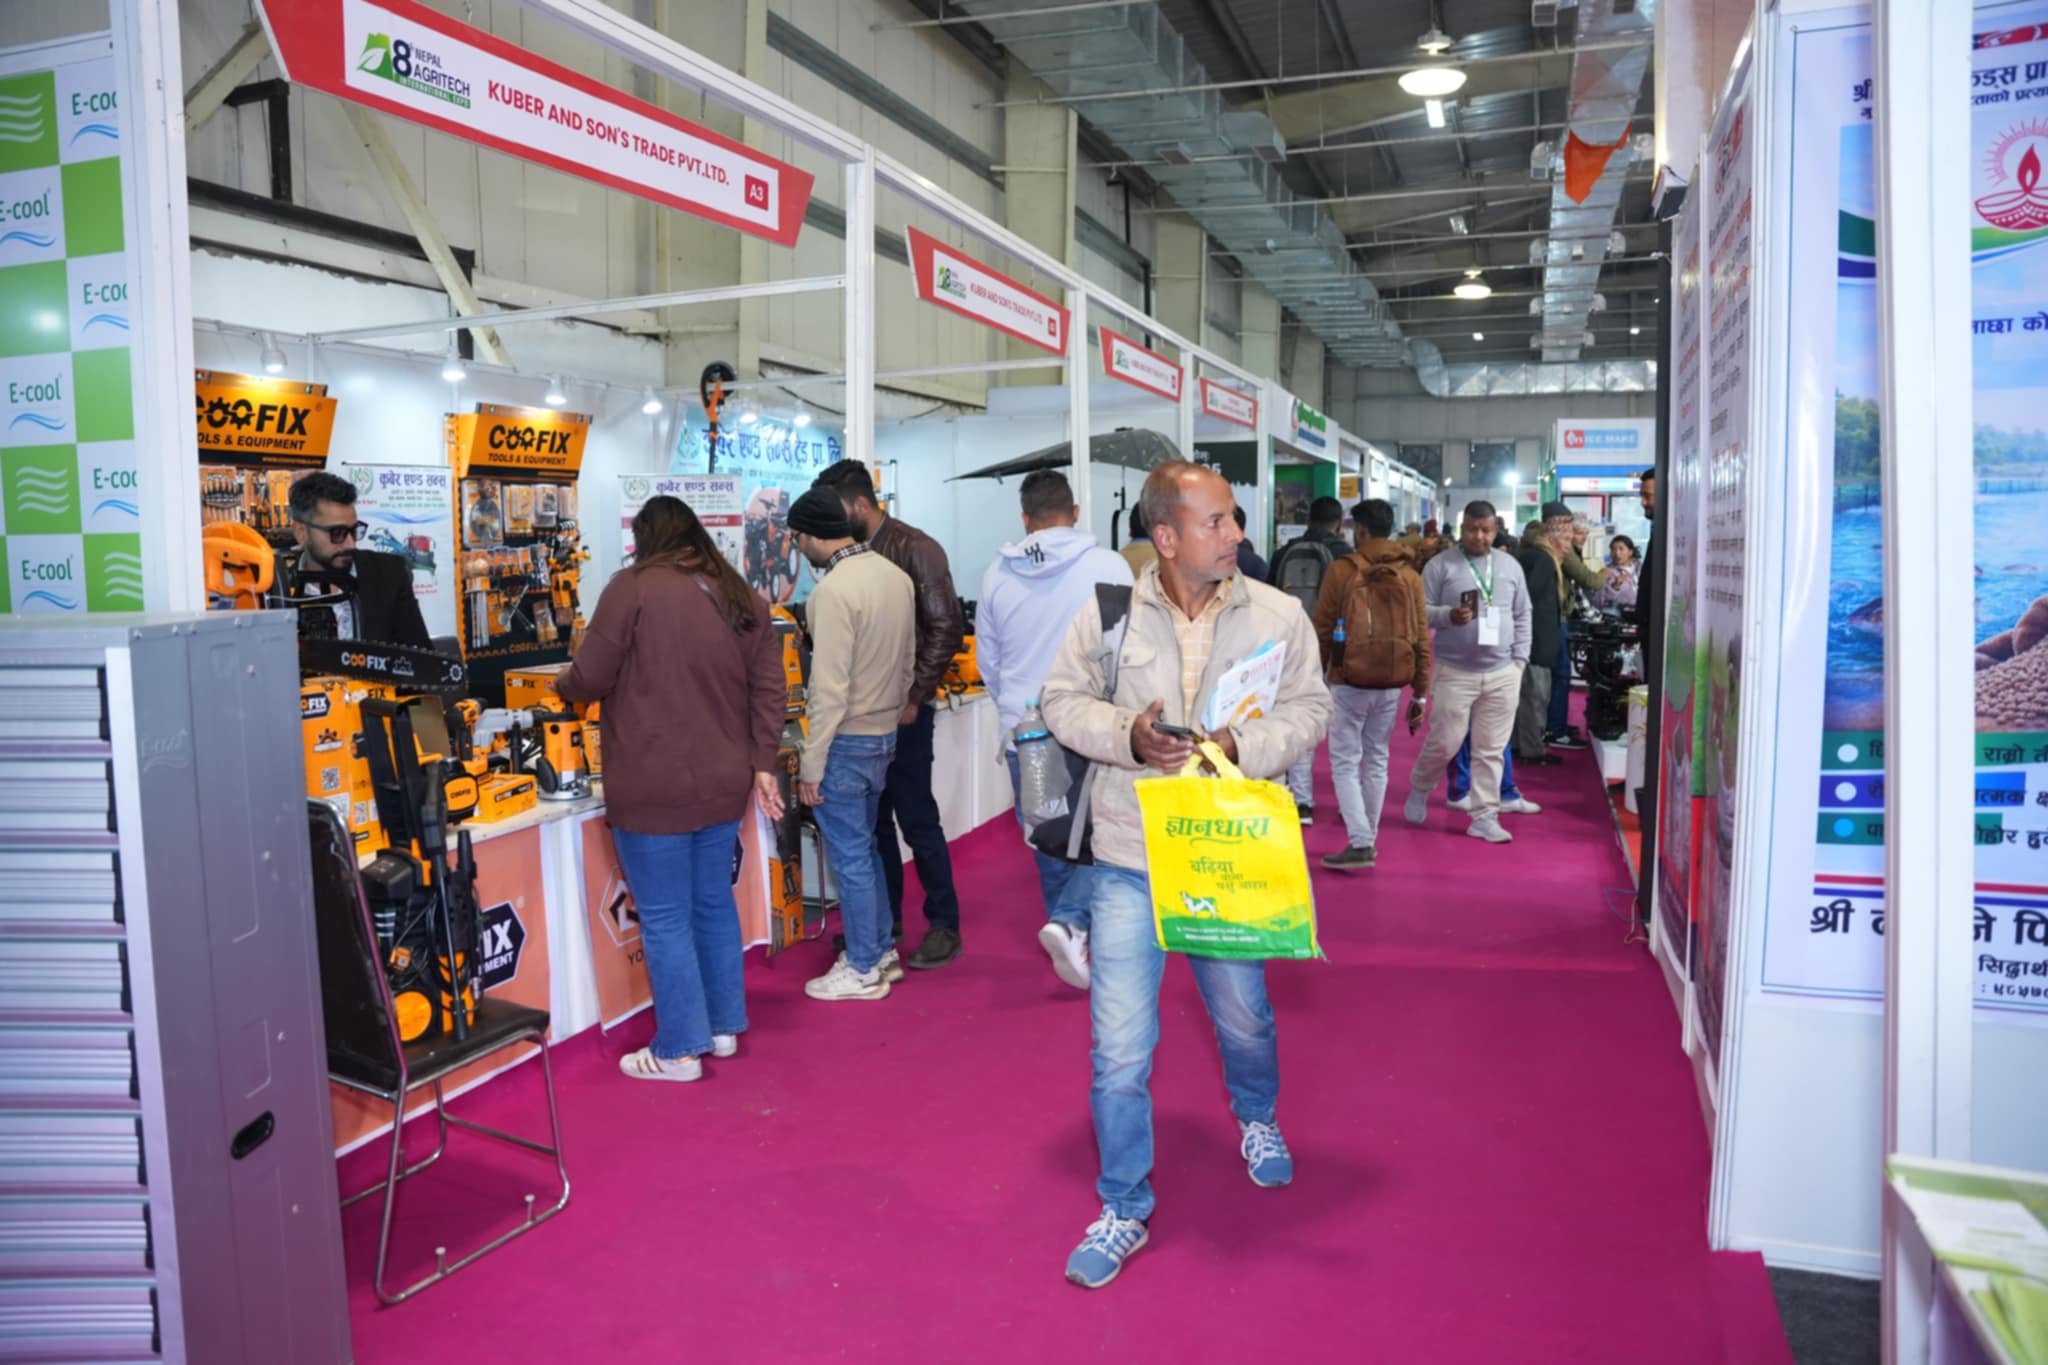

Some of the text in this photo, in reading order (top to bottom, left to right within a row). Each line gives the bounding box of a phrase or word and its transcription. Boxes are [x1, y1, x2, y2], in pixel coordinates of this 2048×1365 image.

[414, 48, 442, 68] NEPAL
[413, 64, 470, 97] AGRITECH
[488, 79, 544, 118] KUBER
[548, 103, 583, 131] AND
[586, 117, 629, 149] SON'S
[632, 134, 676, 166] TRADE
[749, 183, 764, 202] A3
[10, 379, 61, 403] E-cool
[224, 434, 233, 446] &
[237, 435, 305, 450] EQUIPMENT
[489, 424, 571, 454] COOFIX
[488, 452, 514, 463] TOOLS
[523, 455, 566, 466] EQUIPMENT
[22, 556, 73, 581] E-cool
[341, 652, 388, 671] COOFIX
[1809, 898, 1856, 933] श्री
